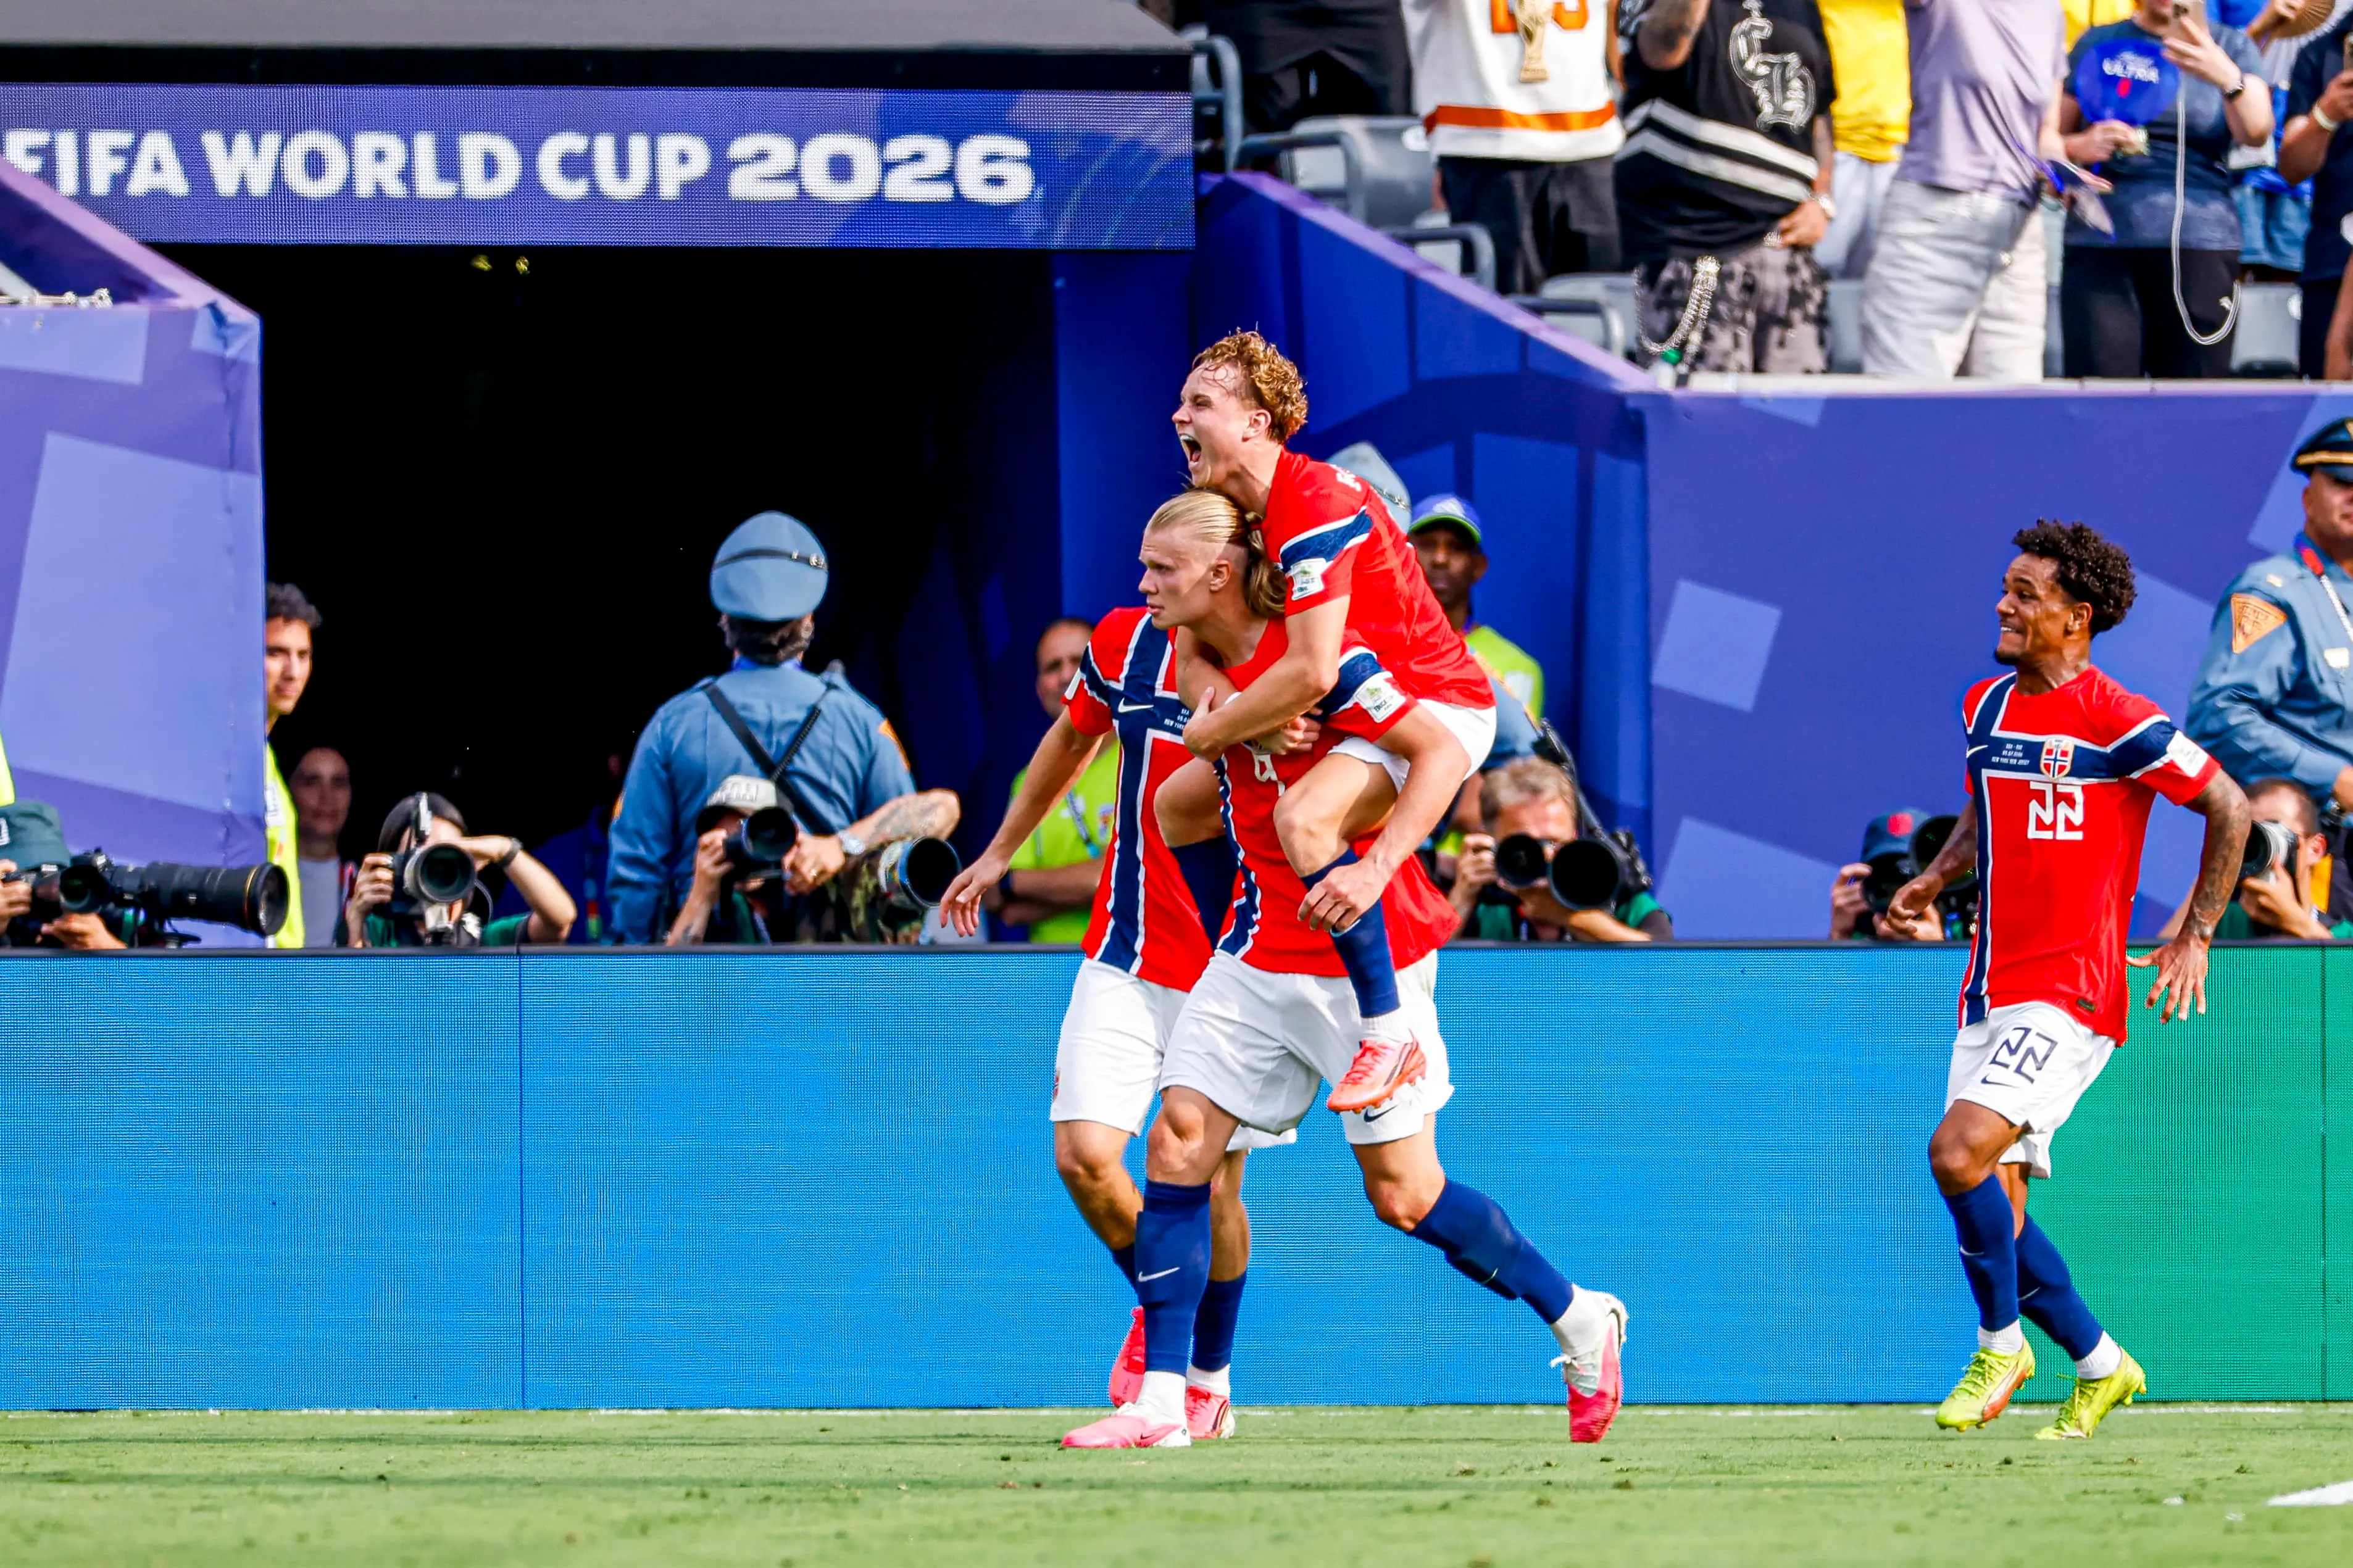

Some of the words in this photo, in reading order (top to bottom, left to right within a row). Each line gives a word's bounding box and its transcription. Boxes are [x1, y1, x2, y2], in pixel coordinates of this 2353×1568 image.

[5, 130, 190, 197] FIFA
[201, 131, 521, 199] WORLD
[537, 131, 711, 200] CUP
[727, 133, 1033, 202] 2026
[1254, 753, 1285, 797] 9
[2027, 781, 2084, 840] 22
[1988, 1027, 2058, 1085] 22
